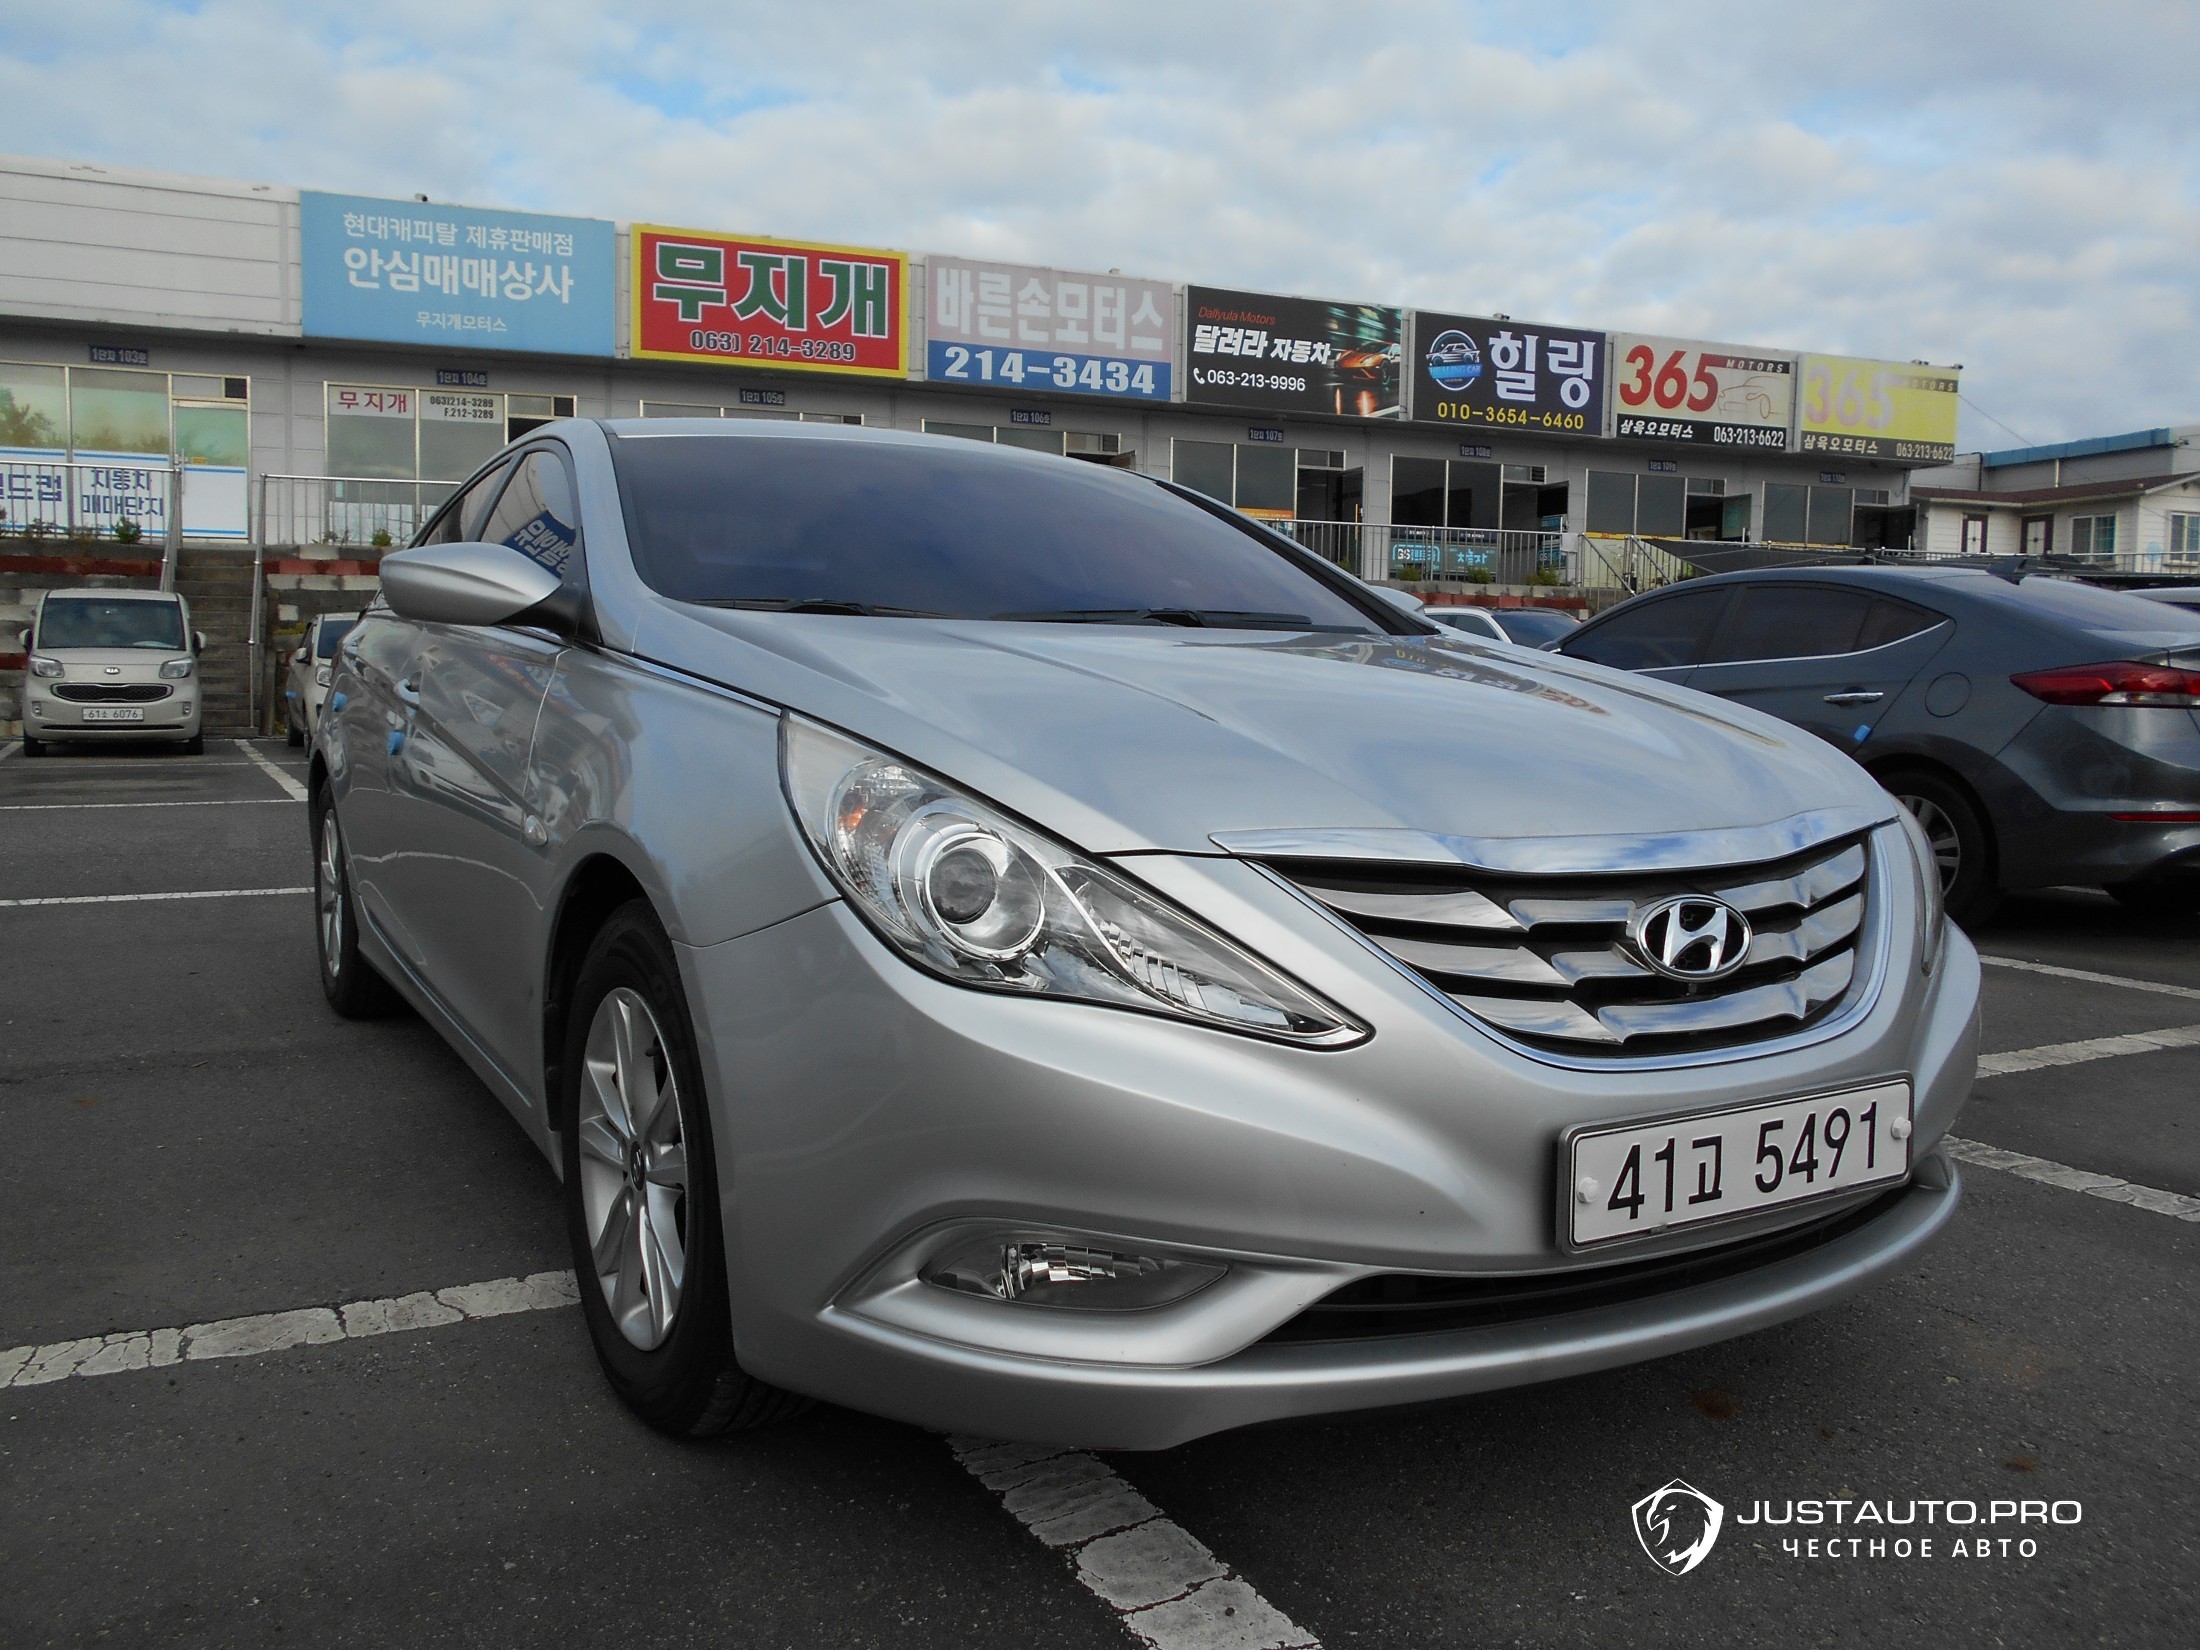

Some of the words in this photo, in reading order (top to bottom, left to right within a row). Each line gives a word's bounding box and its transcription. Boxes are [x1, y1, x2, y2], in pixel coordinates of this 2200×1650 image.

[343, 212, 458, 246] 현대캐피탈
[466, 224, 574, 257] 제휴판매점
[343, 247, 575, 305] 안심매매상사
[653, 241, 889, 340] 무지개
[416, 311, 508, 333] 무지개모터스
[936, 267, 1164, 351] 바른손모터스
[1240, 311, 1277, 326] Motors
[689, 329, 742, 353] 063)
[748, 335, 857, 362] 214-3289
[1193, 324, 1268, 359] 달려라
[1270, 338, 1332, 365] 자동차
[944, 346, 1156, 395] 214-3434
[1206, 369, 1307, 393] 063-213-9996
[1487, 330, 1597, 409] 힐링
[1619, 344, 1719, 413] 365
[1726, 359, 1784, 373] MOTORS
[338, 391, 408, 414] 무지개
[1030, 411, 1050, 424] 106호
[1436, 401, 1585, 431] 010-3654-6460
[1620, 418, 1694, 439] 삼육오모터스
[1803, 434, 1879, 454] 삼육오모터스
[81, 494, 165, 517] 매매단지
[113, 709, 139, 719] 6076
[1607, 1135, 1722, 1220] 41고
[1754, 1100, 1878, 1194] 5491
